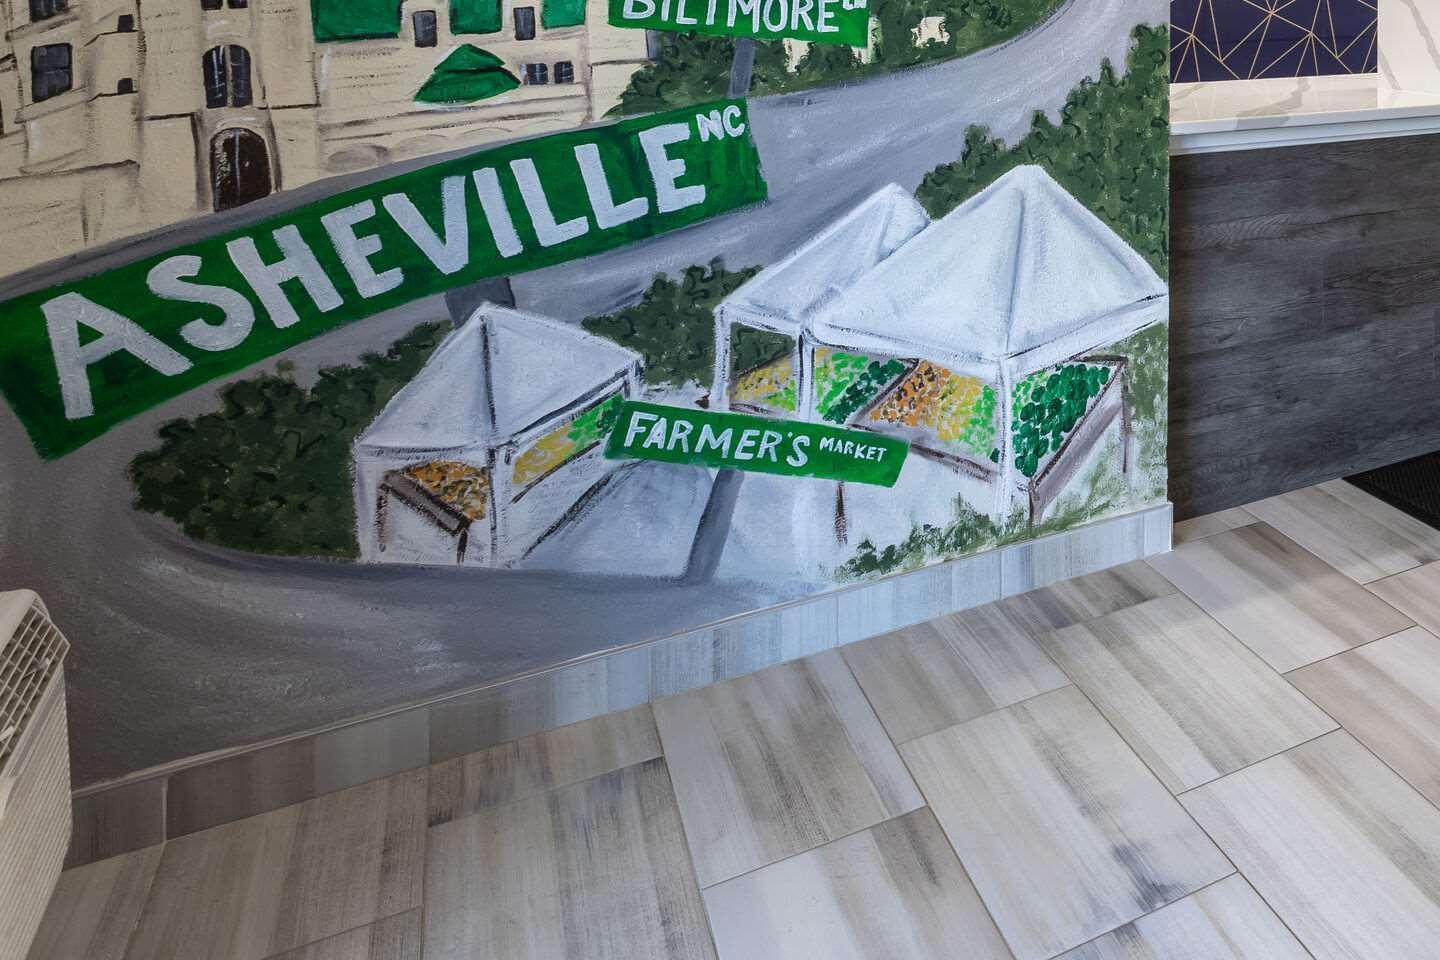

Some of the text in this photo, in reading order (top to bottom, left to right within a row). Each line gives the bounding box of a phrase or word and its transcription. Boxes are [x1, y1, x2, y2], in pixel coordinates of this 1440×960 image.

[40, 105, 746, 421] ASHEVILLE NC
[623, 411, 887, 467] FARMER'S MARKET
